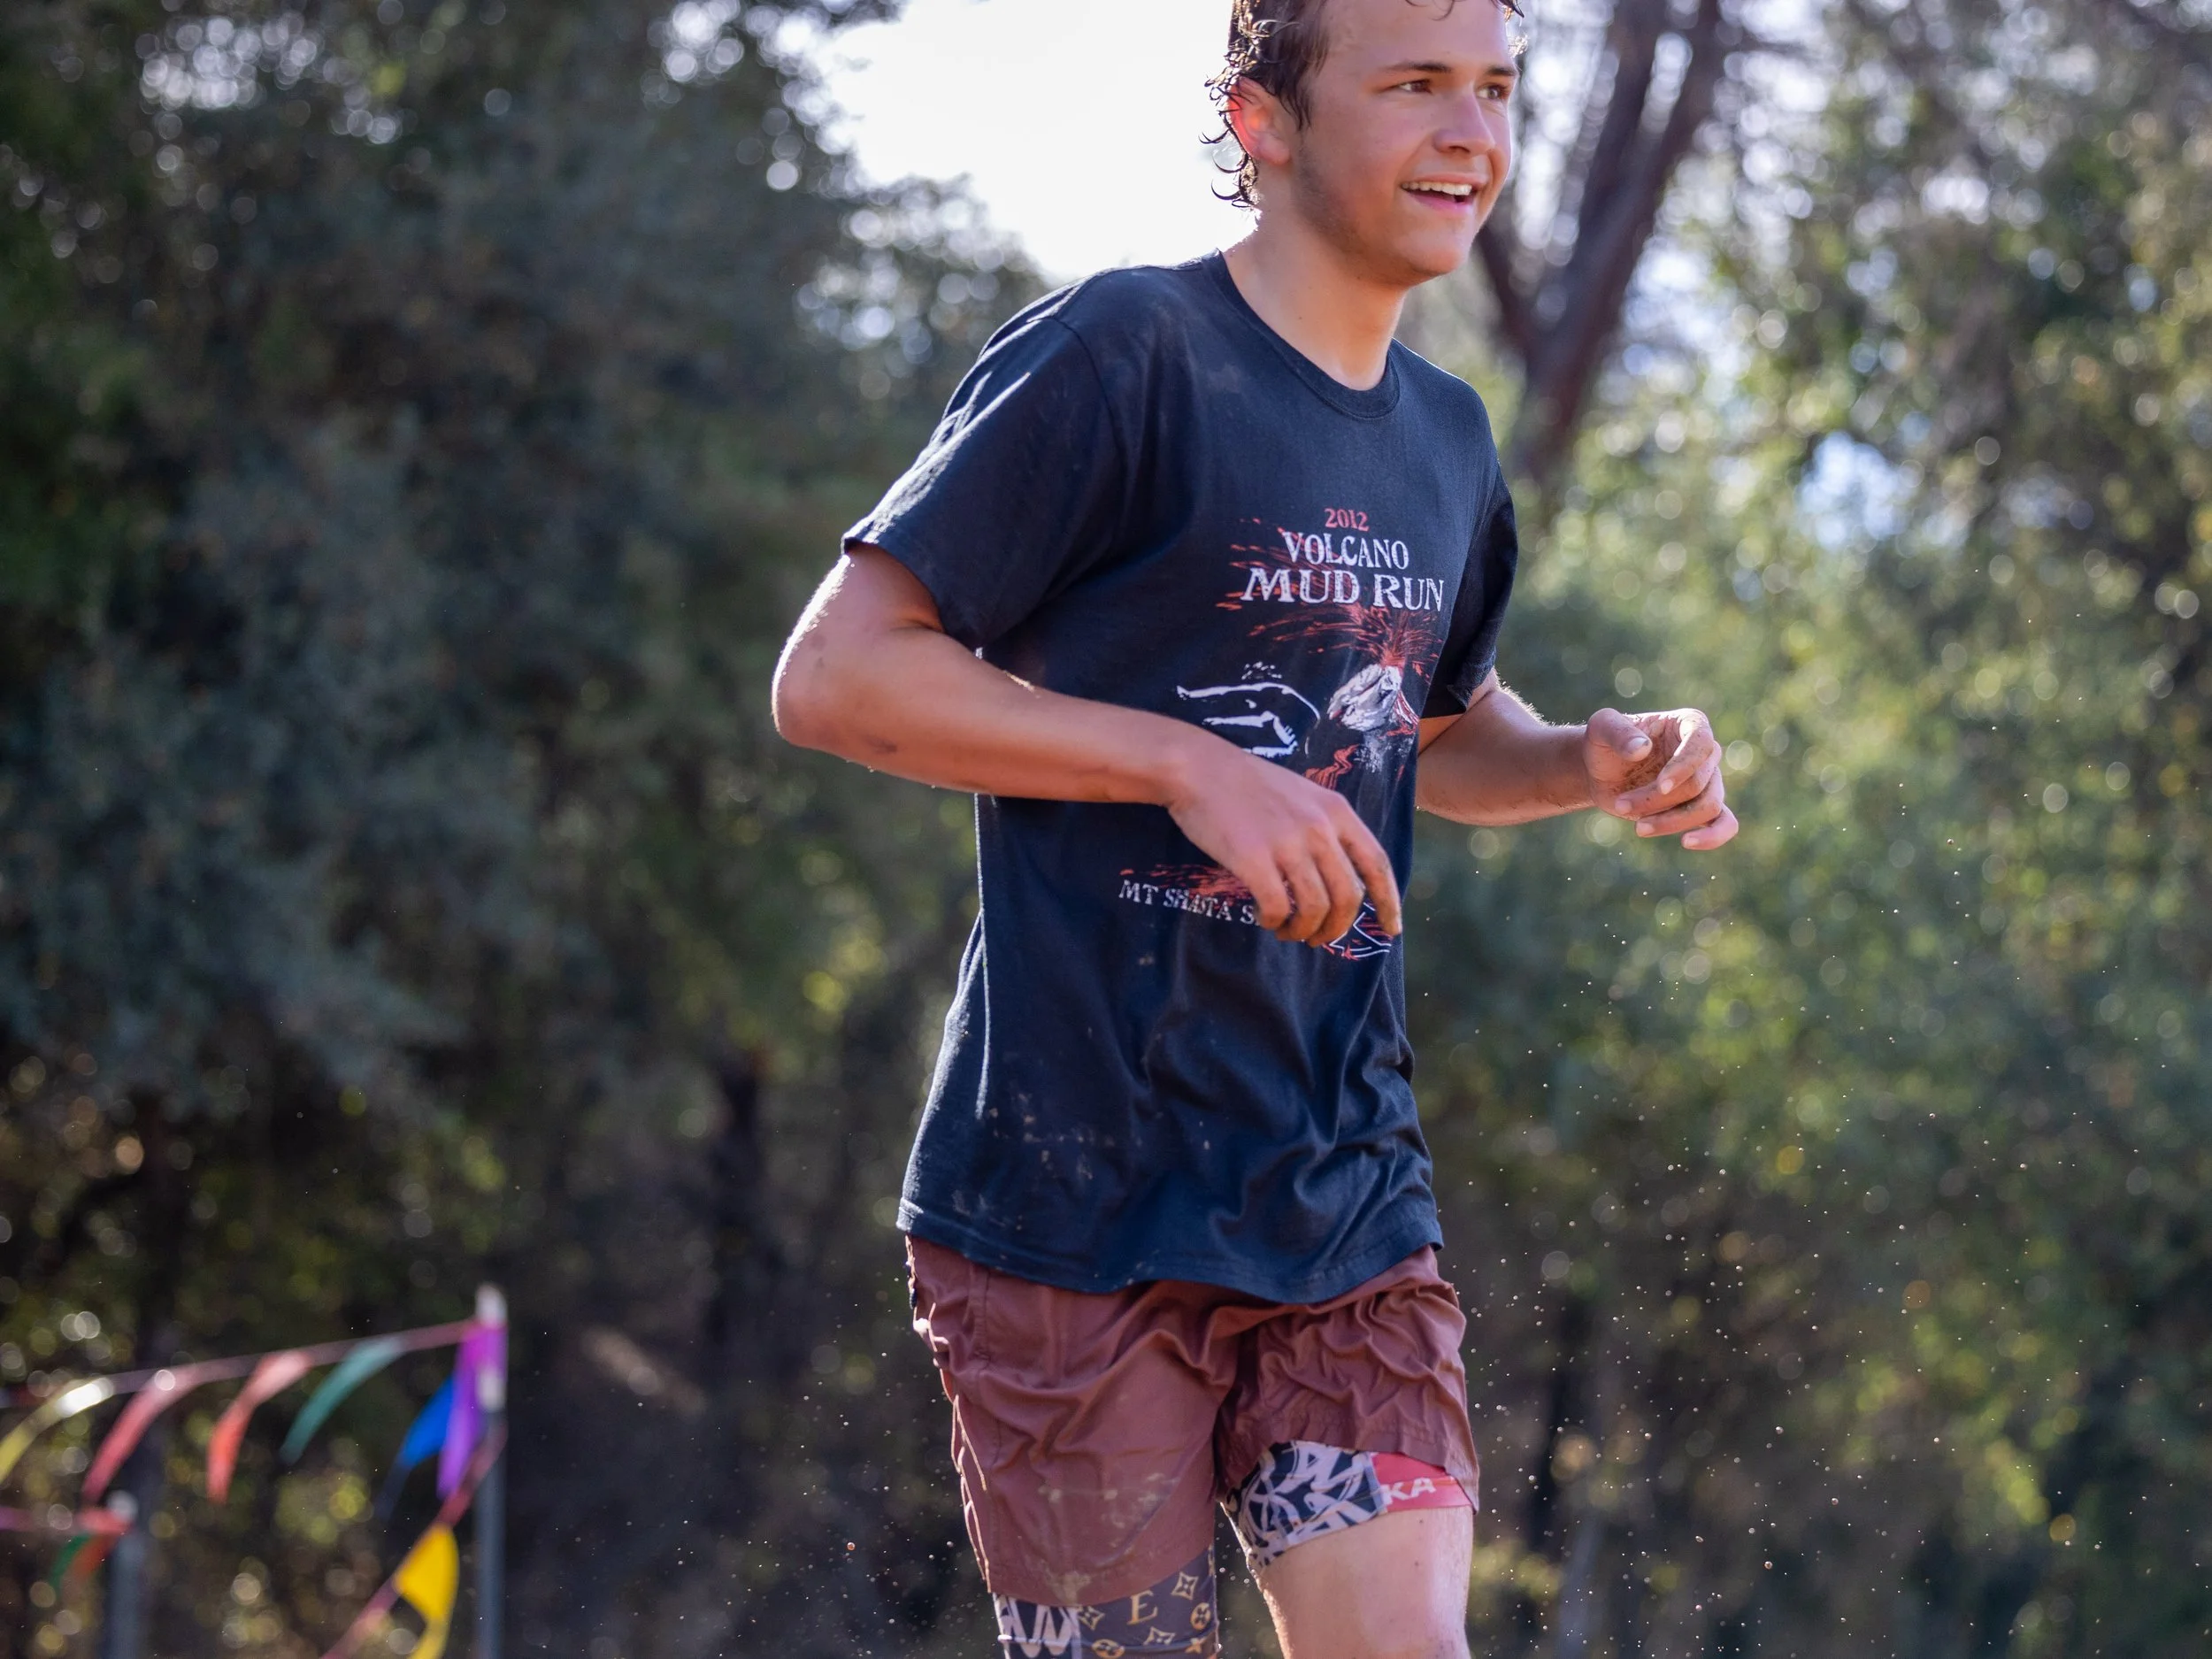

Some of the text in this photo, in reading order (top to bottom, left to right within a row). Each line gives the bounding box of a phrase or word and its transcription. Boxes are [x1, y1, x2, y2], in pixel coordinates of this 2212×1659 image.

[1325, 508, 1370, 532] 2012
[1283, 531, 1409, 570] VOLCANO
[1240, 567, 1445, 612] MUD RUN
[1118, 879, 1159, 905] MT
